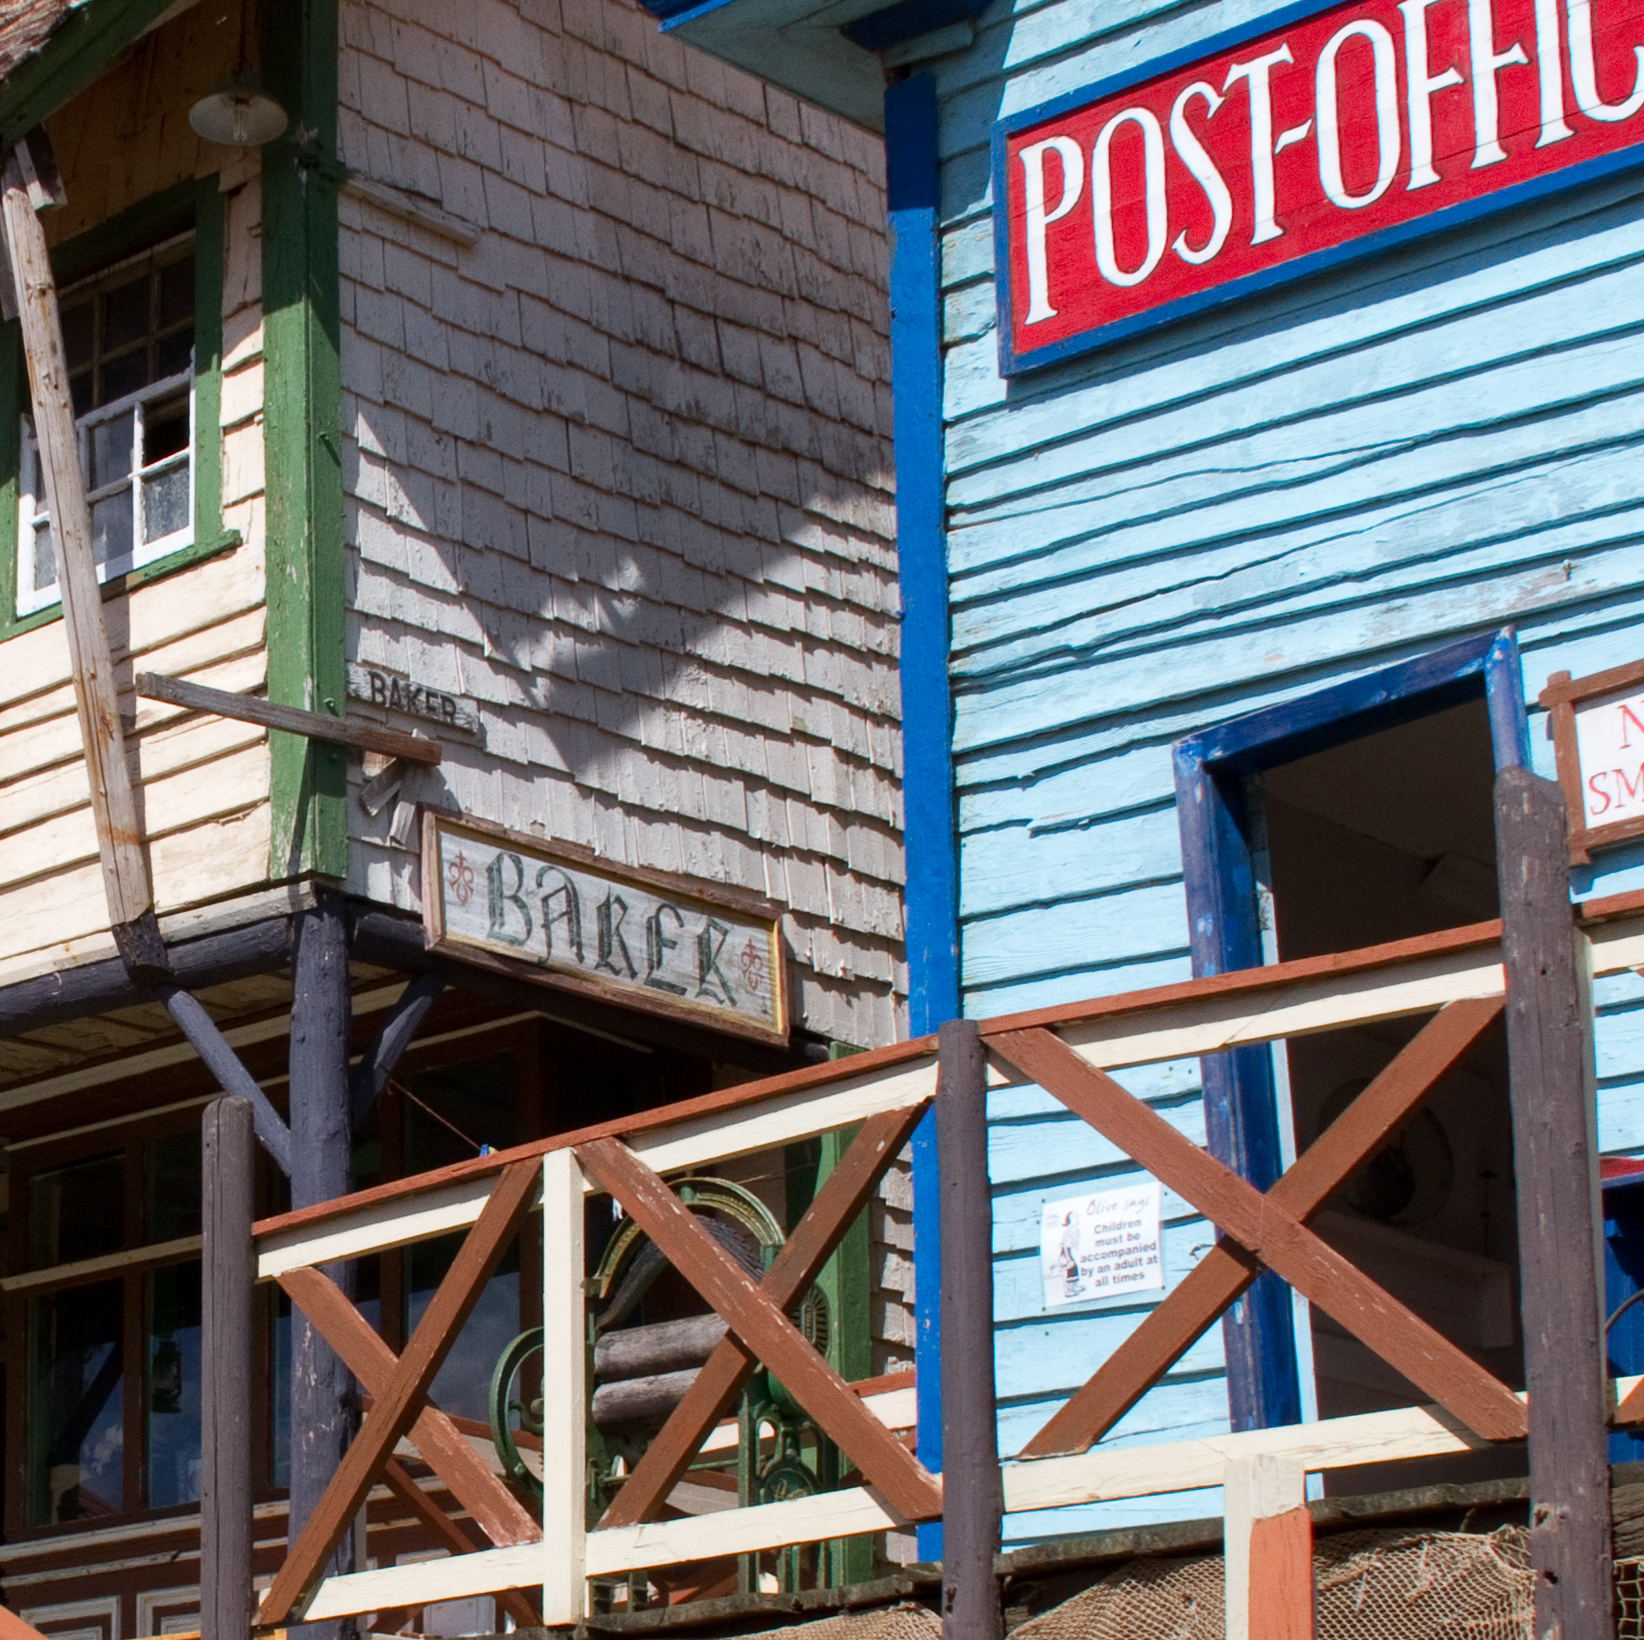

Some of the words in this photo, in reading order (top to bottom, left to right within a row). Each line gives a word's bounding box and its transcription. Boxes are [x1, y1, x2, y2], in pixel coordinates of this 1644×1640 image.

[368, 669, 457, 722] BAKER
[484, 851, 738, 1008] BAKER
[1087, 1199, 1117, 1216] Olive
[1124, 1195, 1150, 1214] says
[1094, 1218, 1142, 1234] Children
[1095, 1234, 1123, 1247] must
[1127, 1232, 1140, 1241] be
[1080, 1241, 1157, 1263] accompanied
[1081, 1267, 1093, 1277] by
[1097, 1264, 1110, 1274] an
[1114, 1257, 1143, 1270] adult
[1146, 1255, 1158, 1265] at
[1095, 1276, 1109, 1287] all
[1112, 1271, 1145, 1284] times
